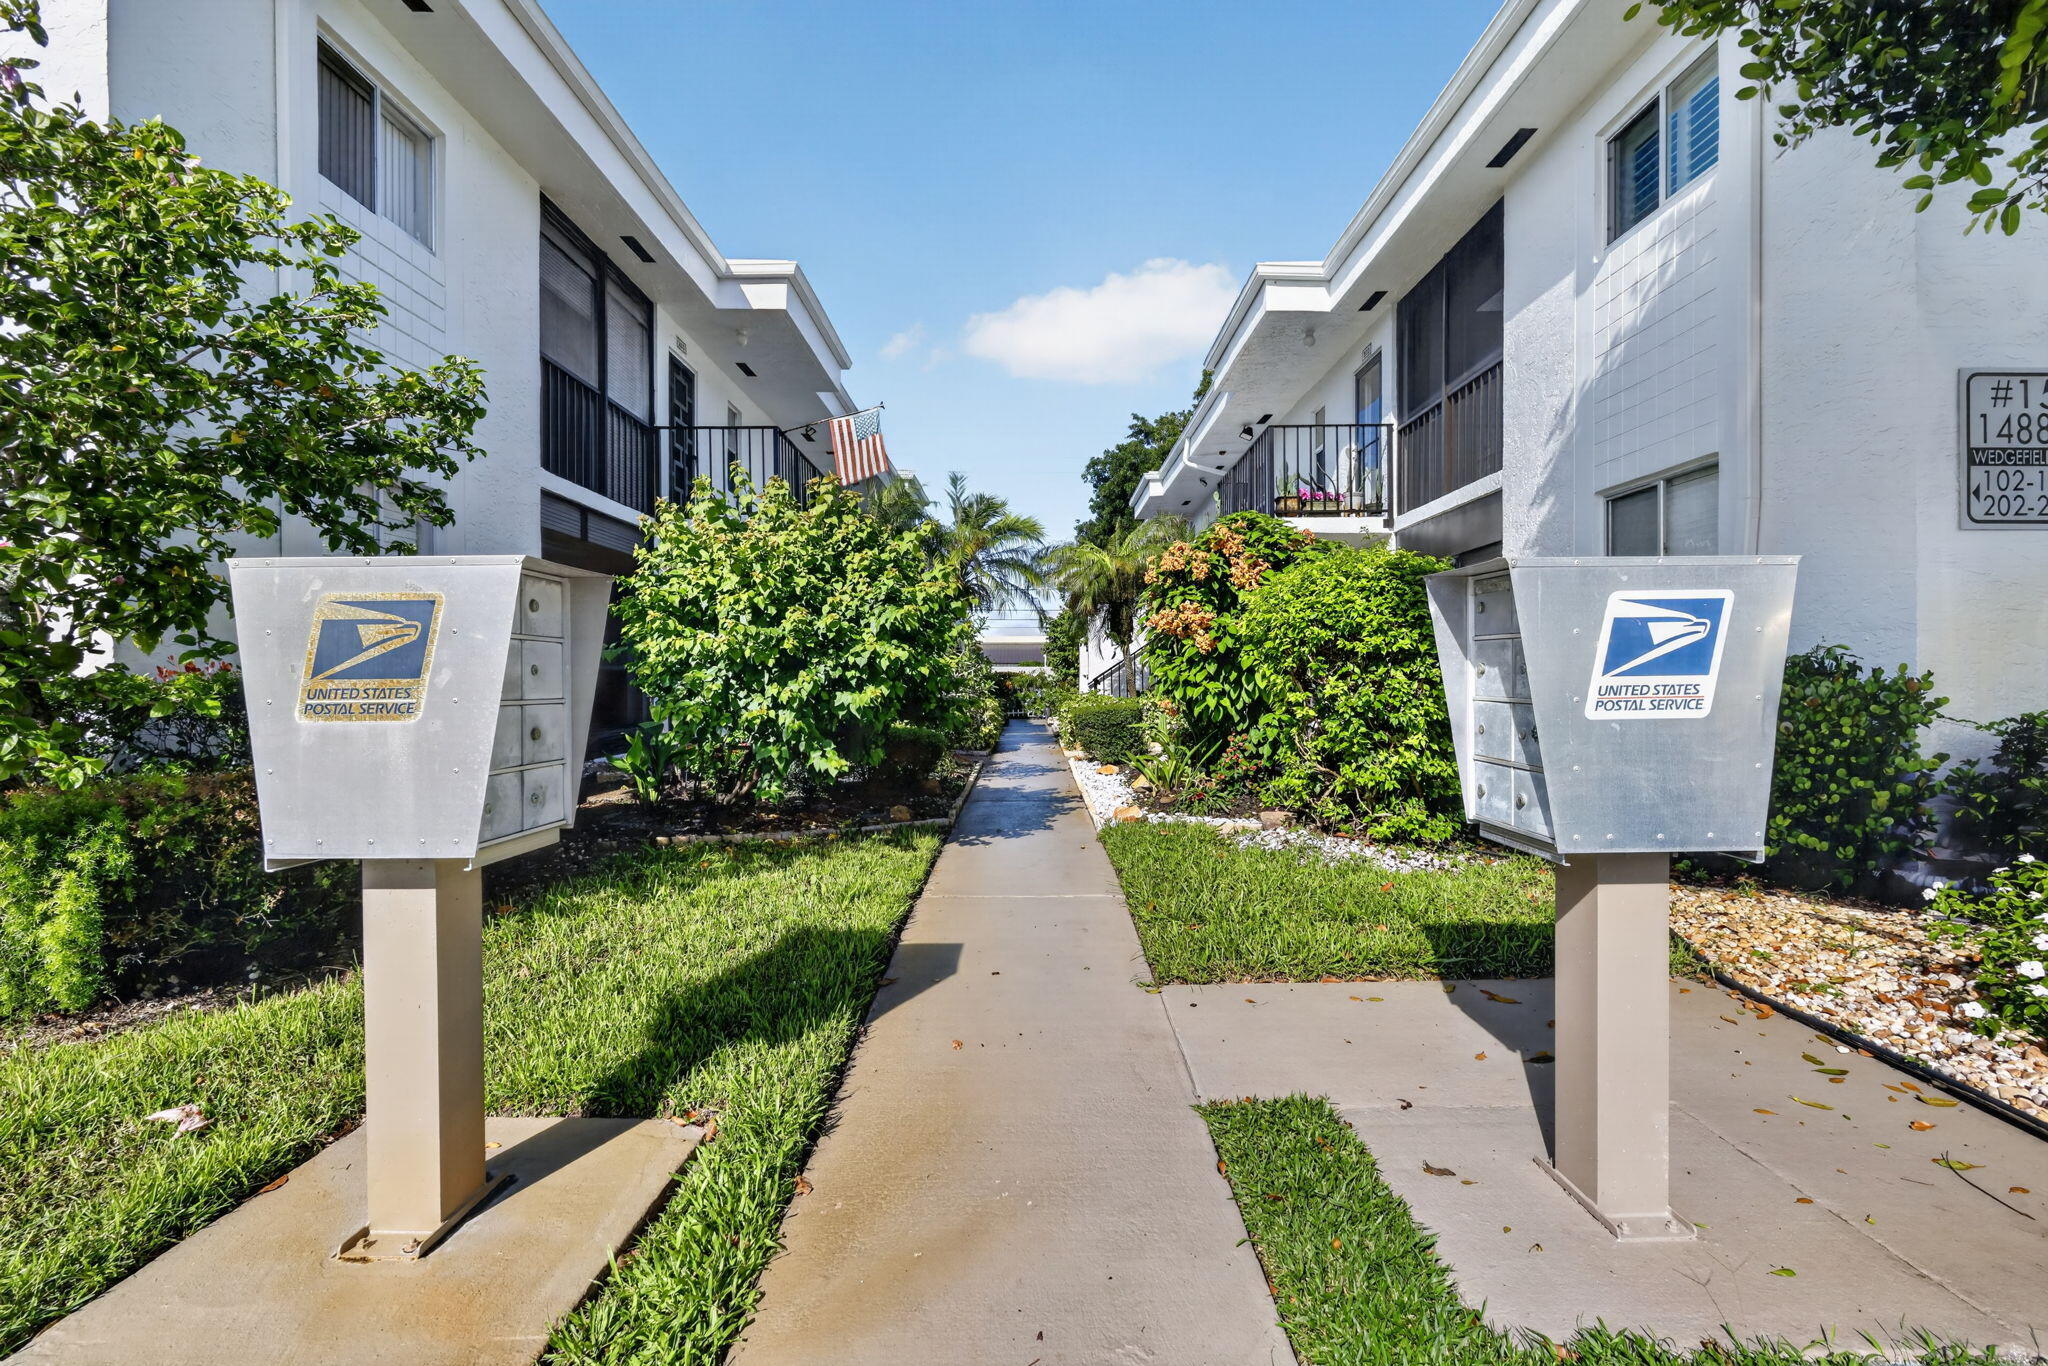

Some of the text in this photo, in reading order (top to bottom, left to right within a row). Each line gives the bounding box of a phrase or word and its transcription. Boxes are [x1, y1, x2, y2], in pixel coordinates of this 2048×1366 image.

[1972, 449, 2048, 464] WEDGEFIEL
[1984, 469, 2045, 491] 102-1
[1984, 494, 2048, 516] 202-2
[307, 687, 411, 700] UNITED STATES
[1598, 684, 1700, 696] UNITED STATES
[304, 702, 416, 714] POSTAL SERVICE
[1595, 698, 1705, 712] POSTAL SERVICE
